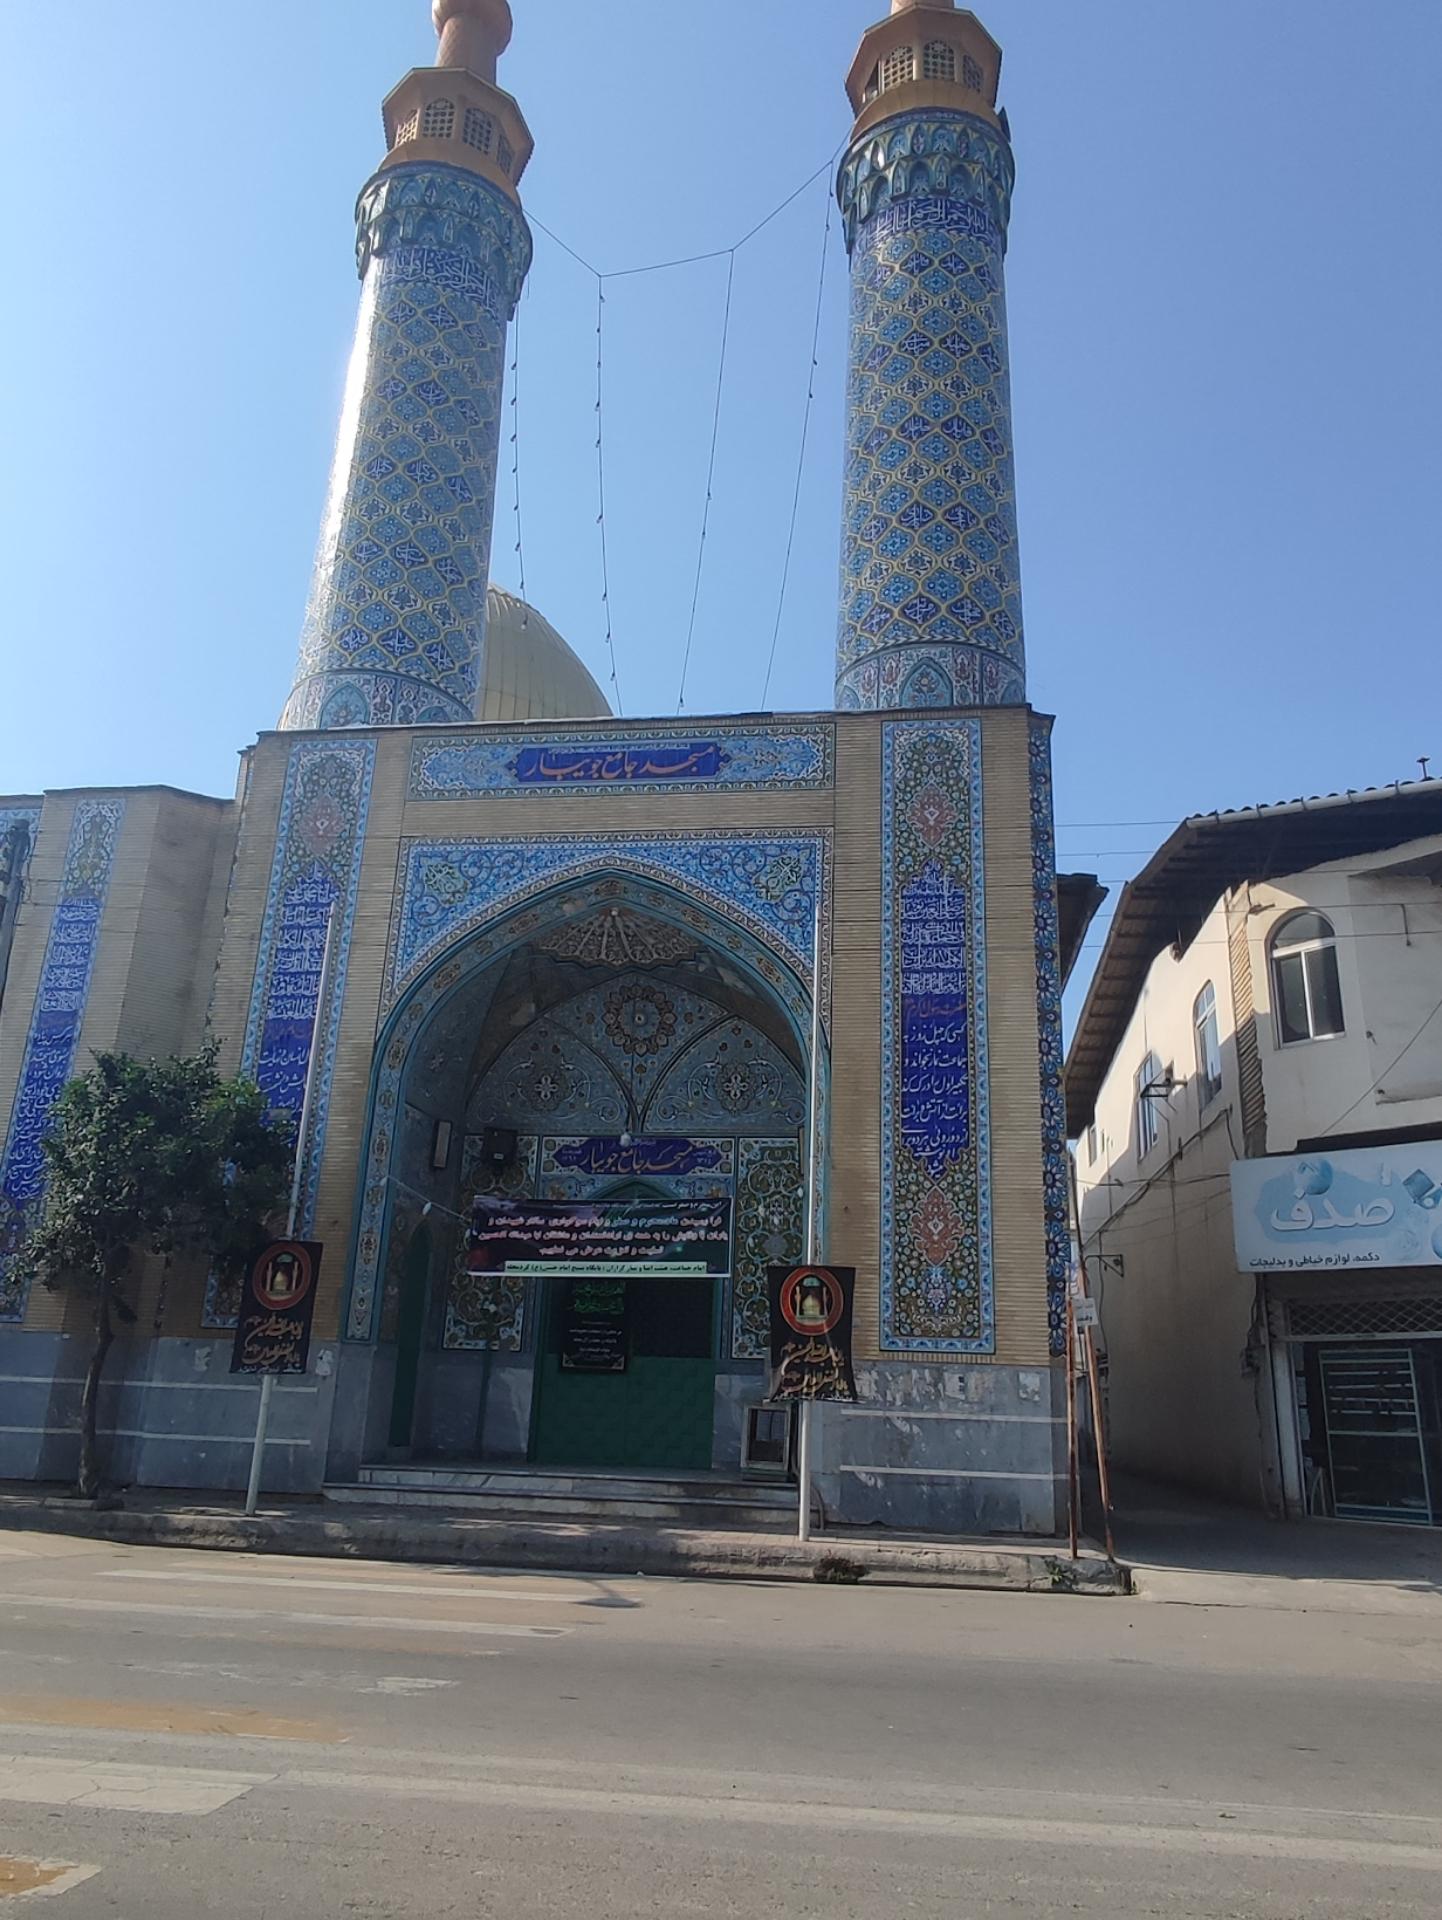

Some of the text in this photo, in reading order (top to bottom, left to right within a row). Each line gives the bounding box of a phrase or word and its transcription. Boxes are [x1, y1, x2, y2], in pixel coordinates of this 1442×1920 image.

[525, 751, 602, 781] جویبار
[601, 751, 638, 780] جامع
[638, 744, 715, 775] مسجد
[578, 1146, 618, 1173] جویبار
[617, 1147, 645, 1175] جامع
[643, 1145, 693, 1171] مسجد
[1269, 1186, 1396, 1231] صدف
[1249, 1257, 1287, 1268] بدلیجات
[1288, 1259, 1294, 1267] و
[1295, 1254, 1323, 1267] خیاطی
[1325, 1253, 1350, 1266] لوازم
